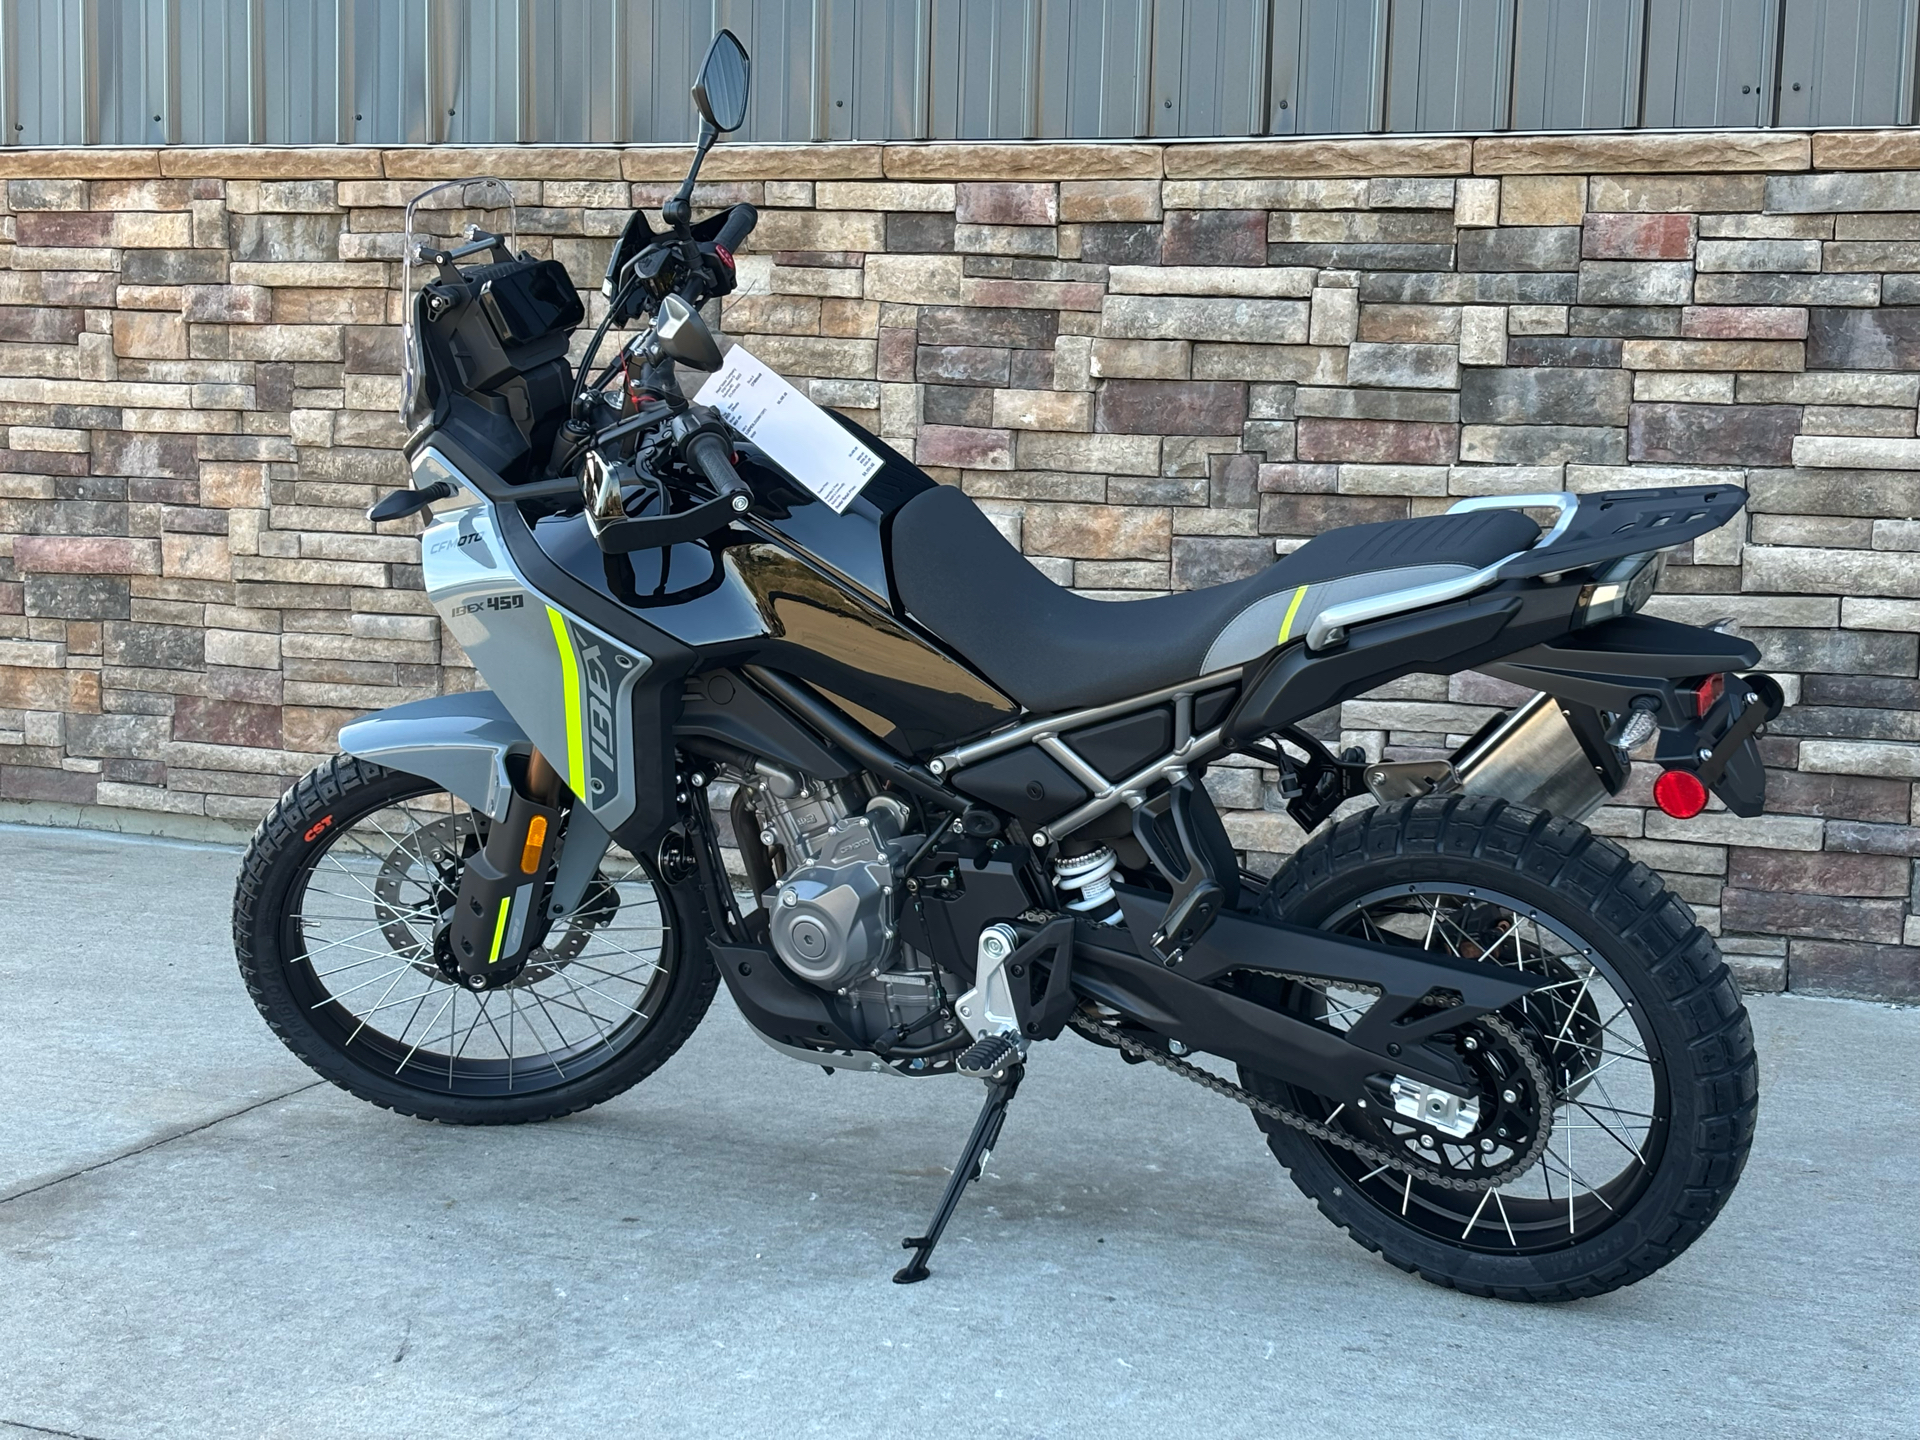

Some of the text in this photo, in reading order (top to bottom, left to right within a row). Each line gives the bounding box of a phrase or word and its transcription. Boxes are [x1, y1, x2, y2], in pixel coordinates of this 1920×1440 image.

[430, 531, 484, 554] CFMOTO
[451, 594, 524, 618] IBEX 450
[572, 625, 614, 773] IBEX
[304, 814, 334, 843] CST
